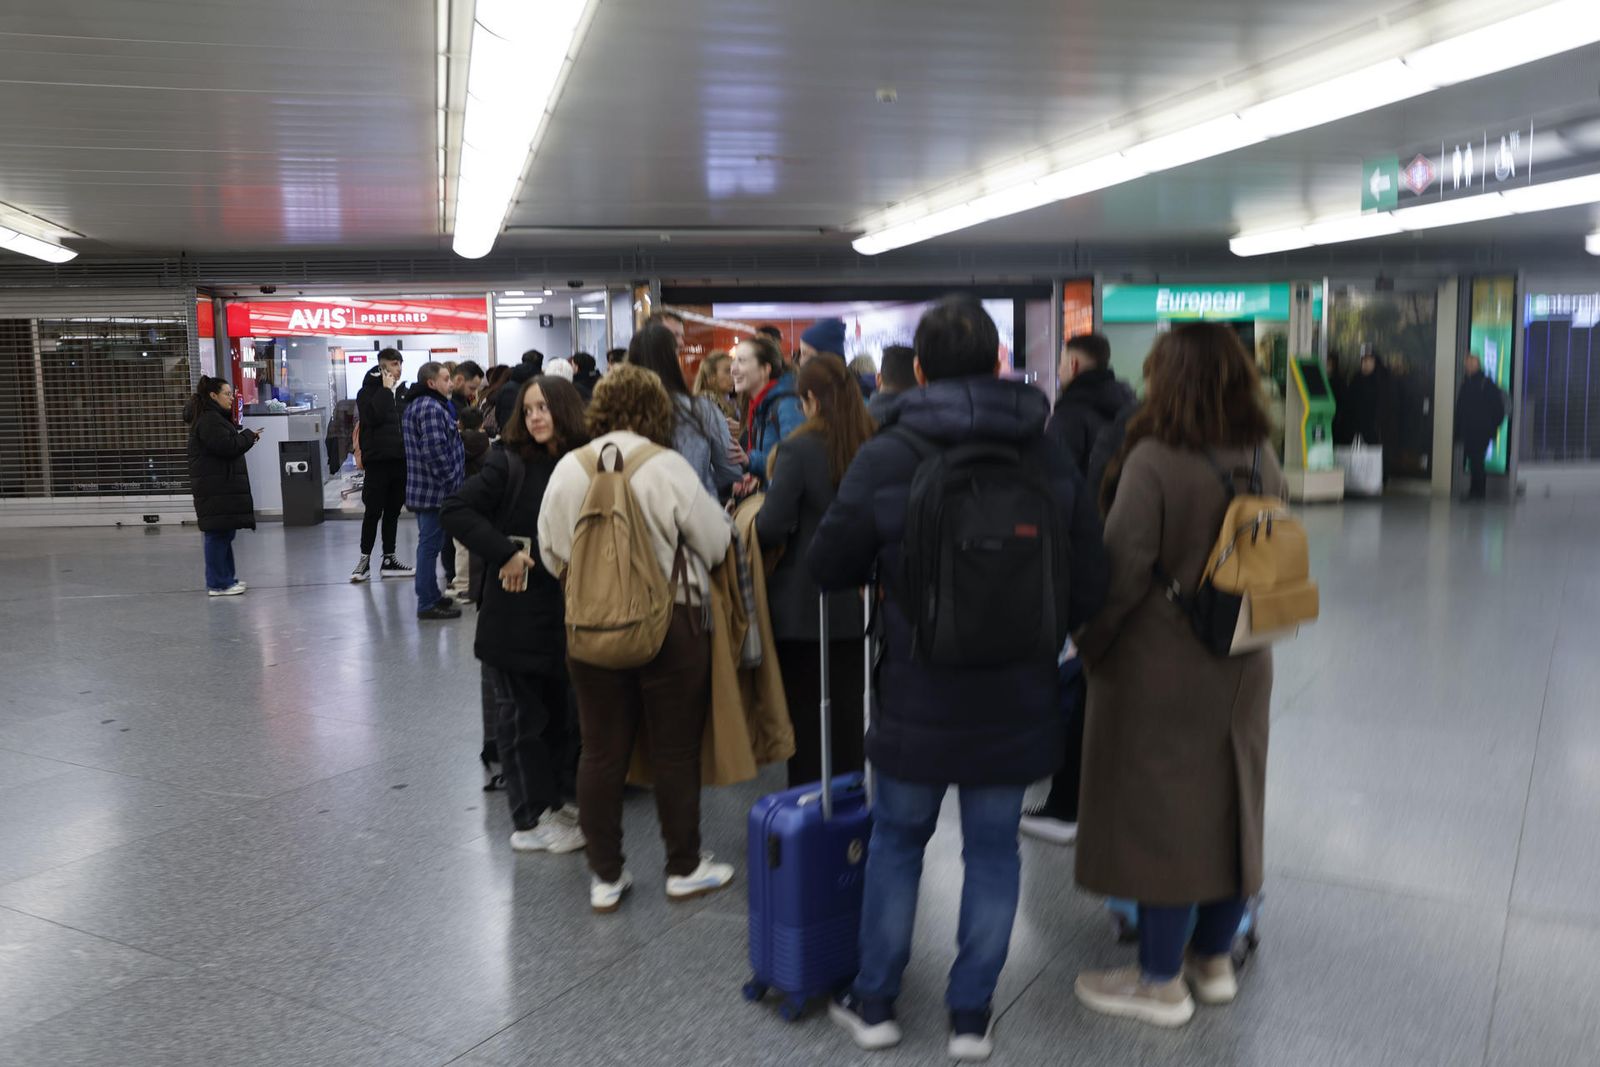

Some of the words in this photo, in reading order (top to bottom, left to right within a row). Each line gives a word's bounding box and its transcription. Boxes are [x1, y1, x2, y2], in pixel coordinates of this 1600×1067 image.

[1156, 288, 1245, 318] Europcar
[288, 308, 347, 329] AVIS
[361, 313, 428, 323] PREFERRED
